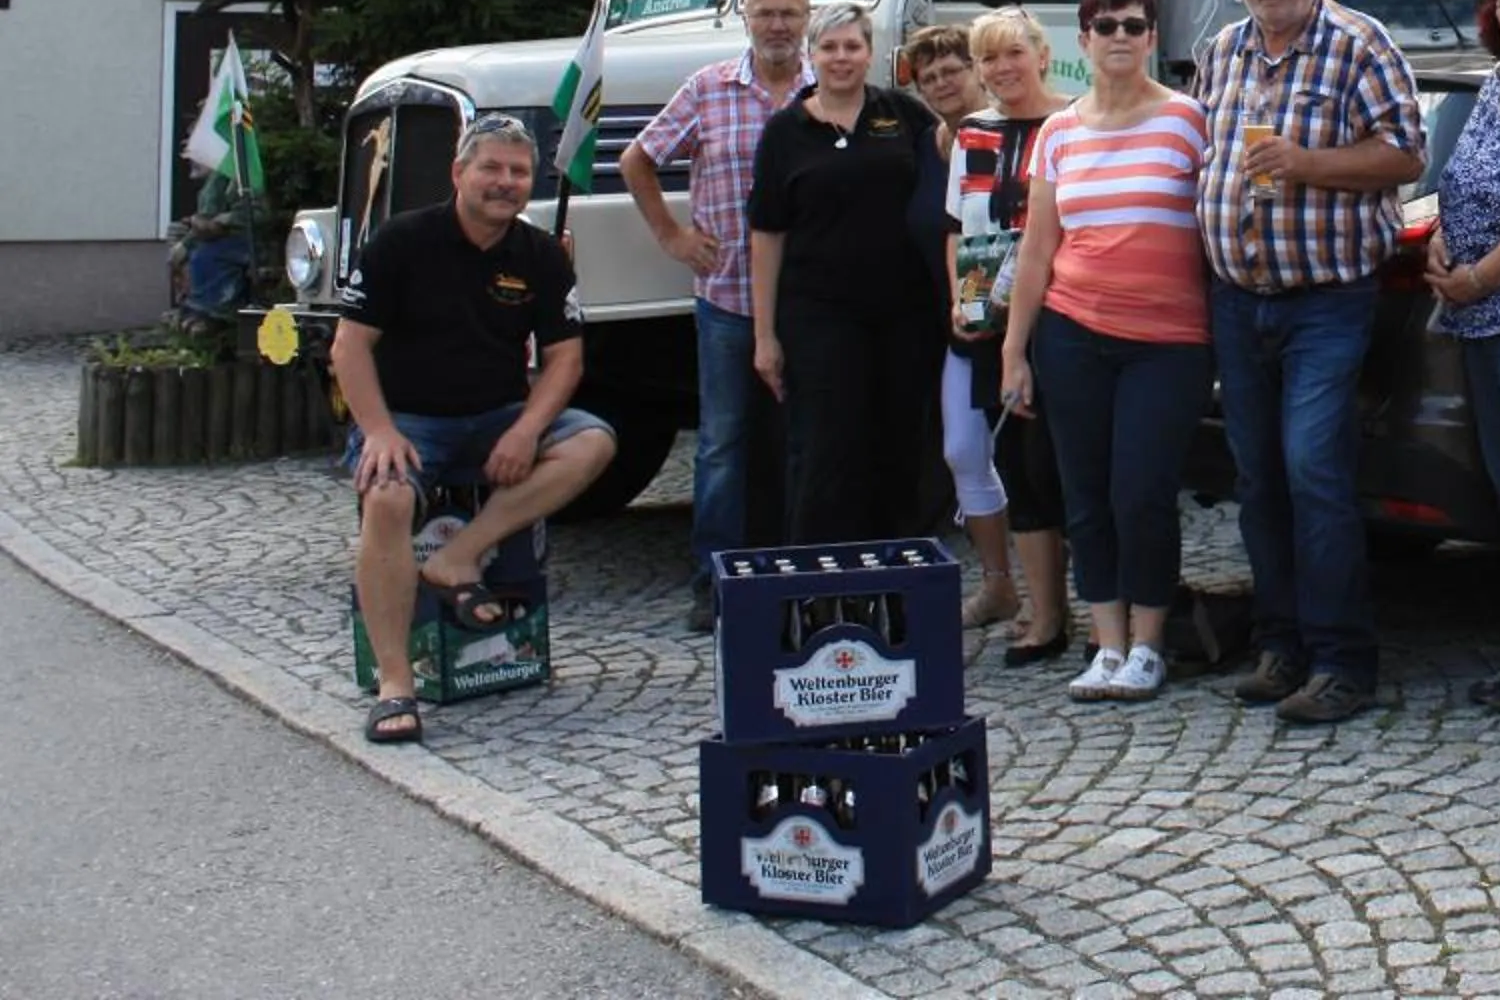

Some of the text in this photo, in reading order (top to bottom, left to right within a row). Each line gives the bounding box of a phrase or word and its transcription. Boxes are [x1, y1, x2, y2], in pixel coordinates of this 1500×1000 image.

[454, 662, 542, 690] Weltenburger
[789, 673, 900, 692] Weltenburger
[796, 687, 893, 707] Kloster Bier
[761, 863, 845, 885] Kloster Bier
